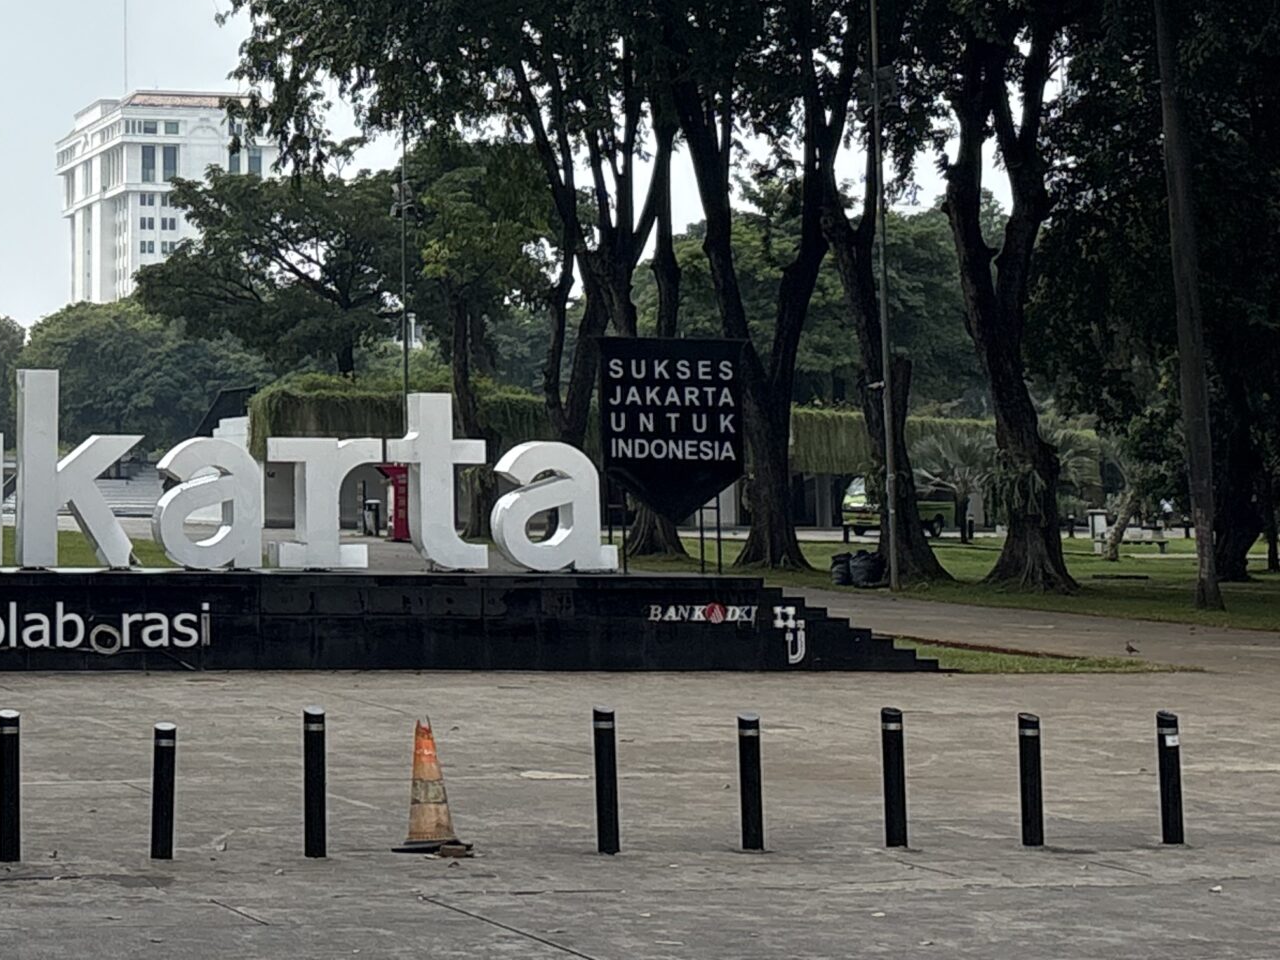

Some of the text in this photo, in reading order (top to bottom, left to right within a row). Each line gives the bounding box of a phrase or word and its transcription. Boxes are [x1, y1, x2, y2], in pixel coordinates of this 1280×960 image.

[608, 358, 734, 381] SUKSES
[608, 385, 735, 408] JAKARTA
[610, 412, 737, 434] UNTUK
[611, 438, 737, 461] INDONESIA
[648, 604, 759, 624] BANK DKI
